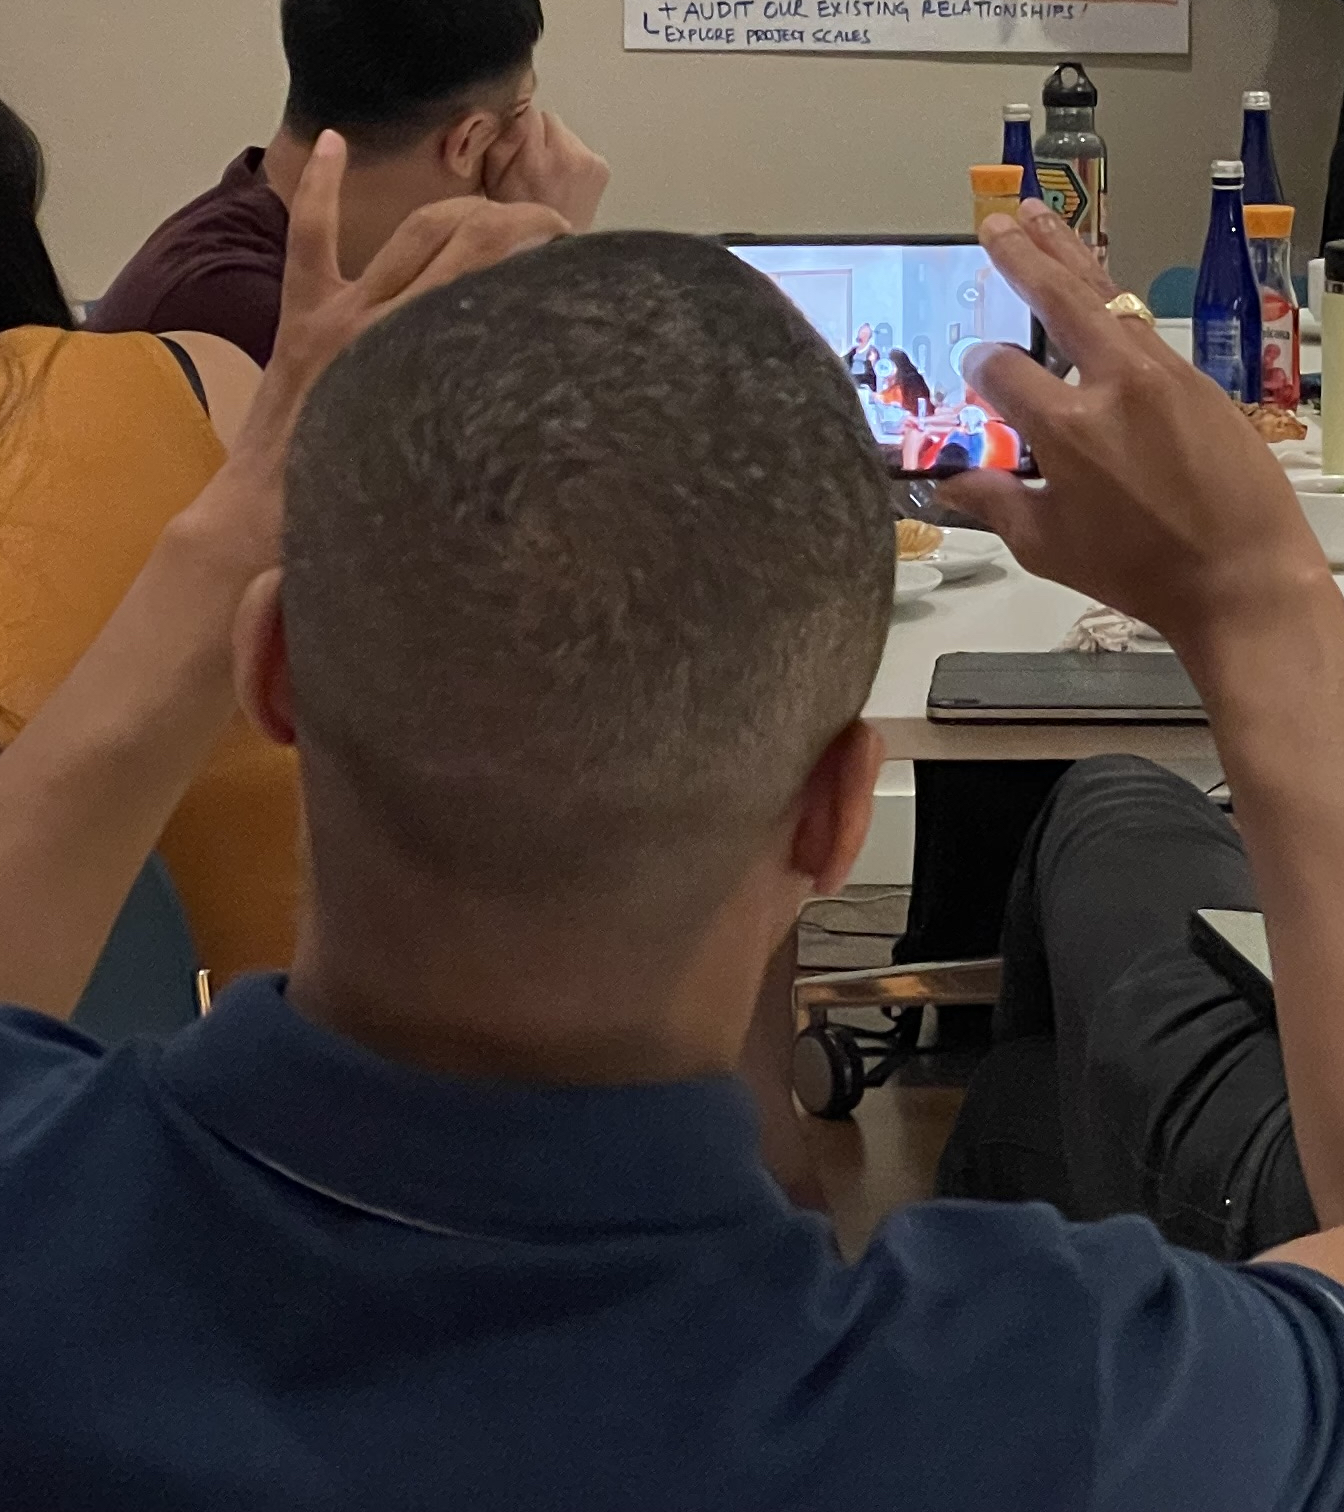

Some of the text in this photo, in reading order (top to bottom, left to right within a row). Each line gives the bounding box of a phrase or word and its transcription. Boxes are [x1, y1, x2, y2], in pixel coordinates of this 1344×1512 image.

[683, 0, 908, 23] AUDIT OUR EXISTING
[664, 25, 870, 45] EXPLORE PROJECT SCALES
